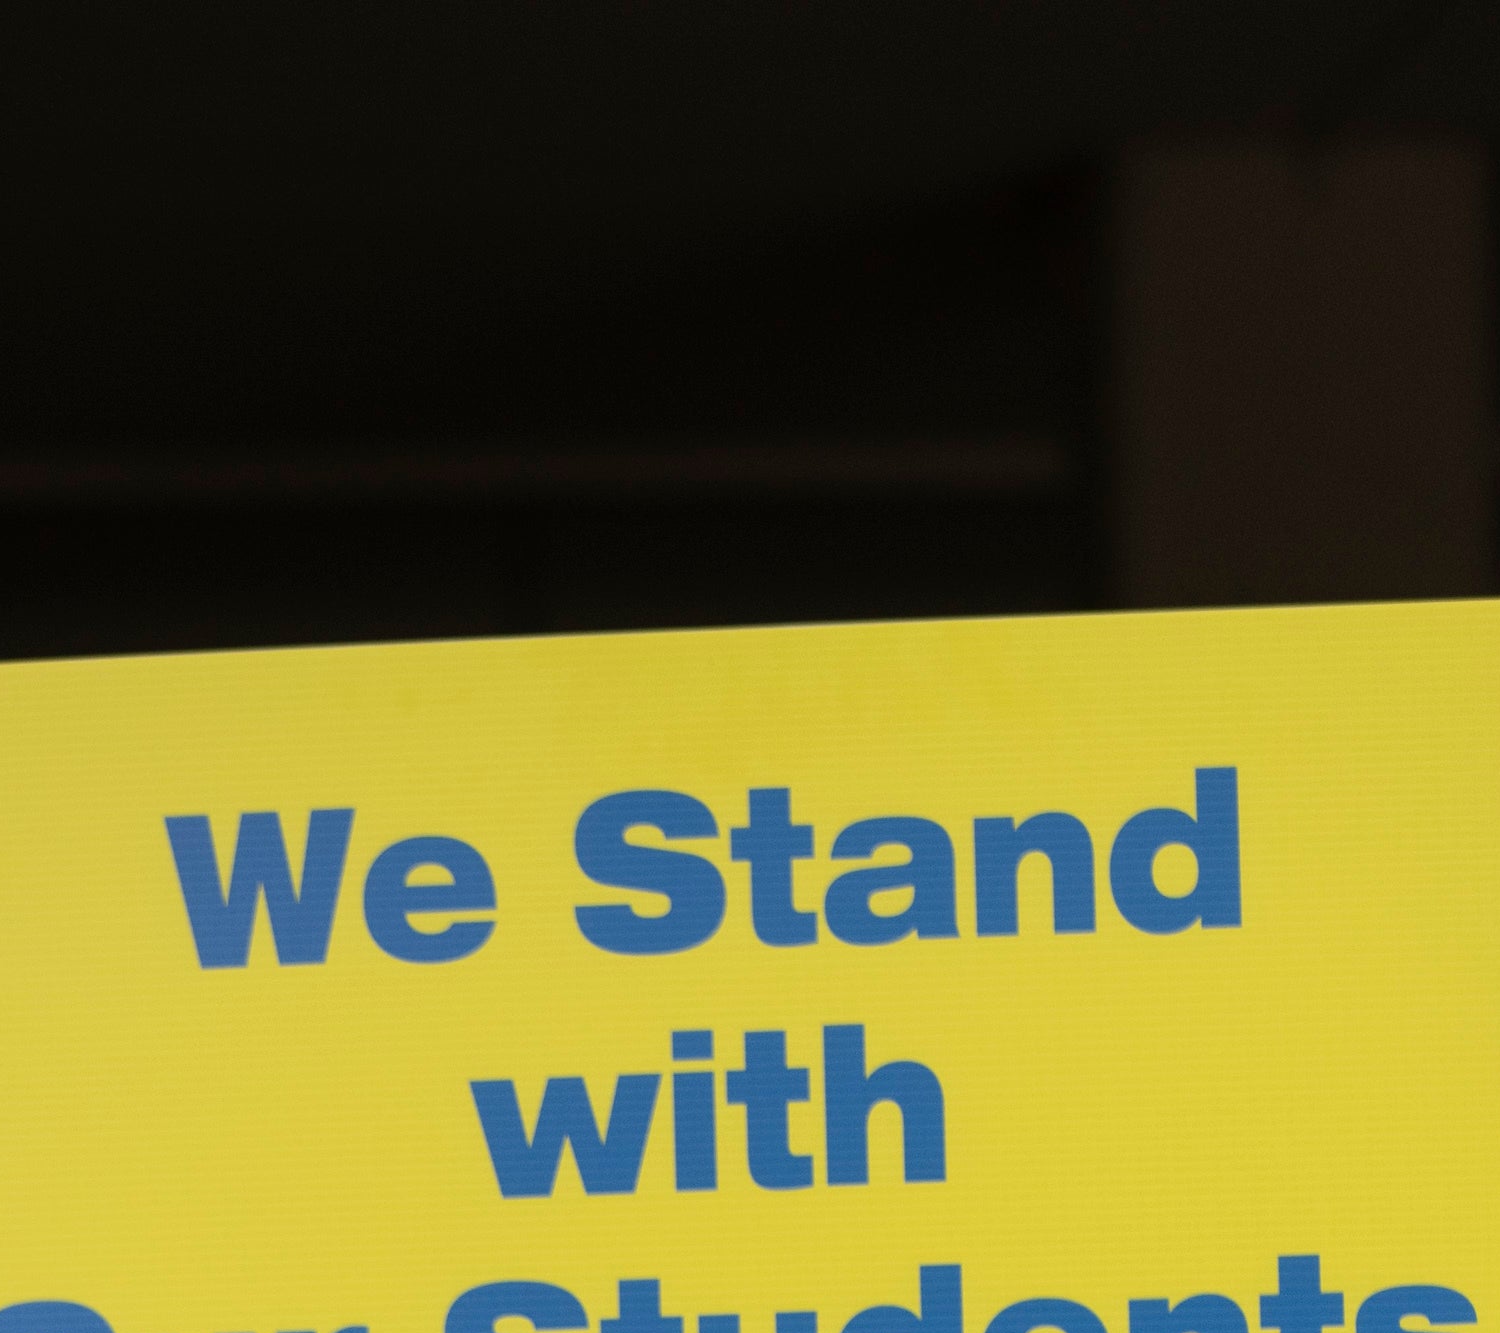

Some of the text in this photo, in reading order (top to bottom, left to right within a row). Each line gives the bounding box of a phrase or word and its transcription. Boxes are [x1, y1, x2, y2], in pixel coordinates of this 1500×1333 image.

[163, 766, 1242, 970] We Stand
[469, 1023, 947, 1199] with
